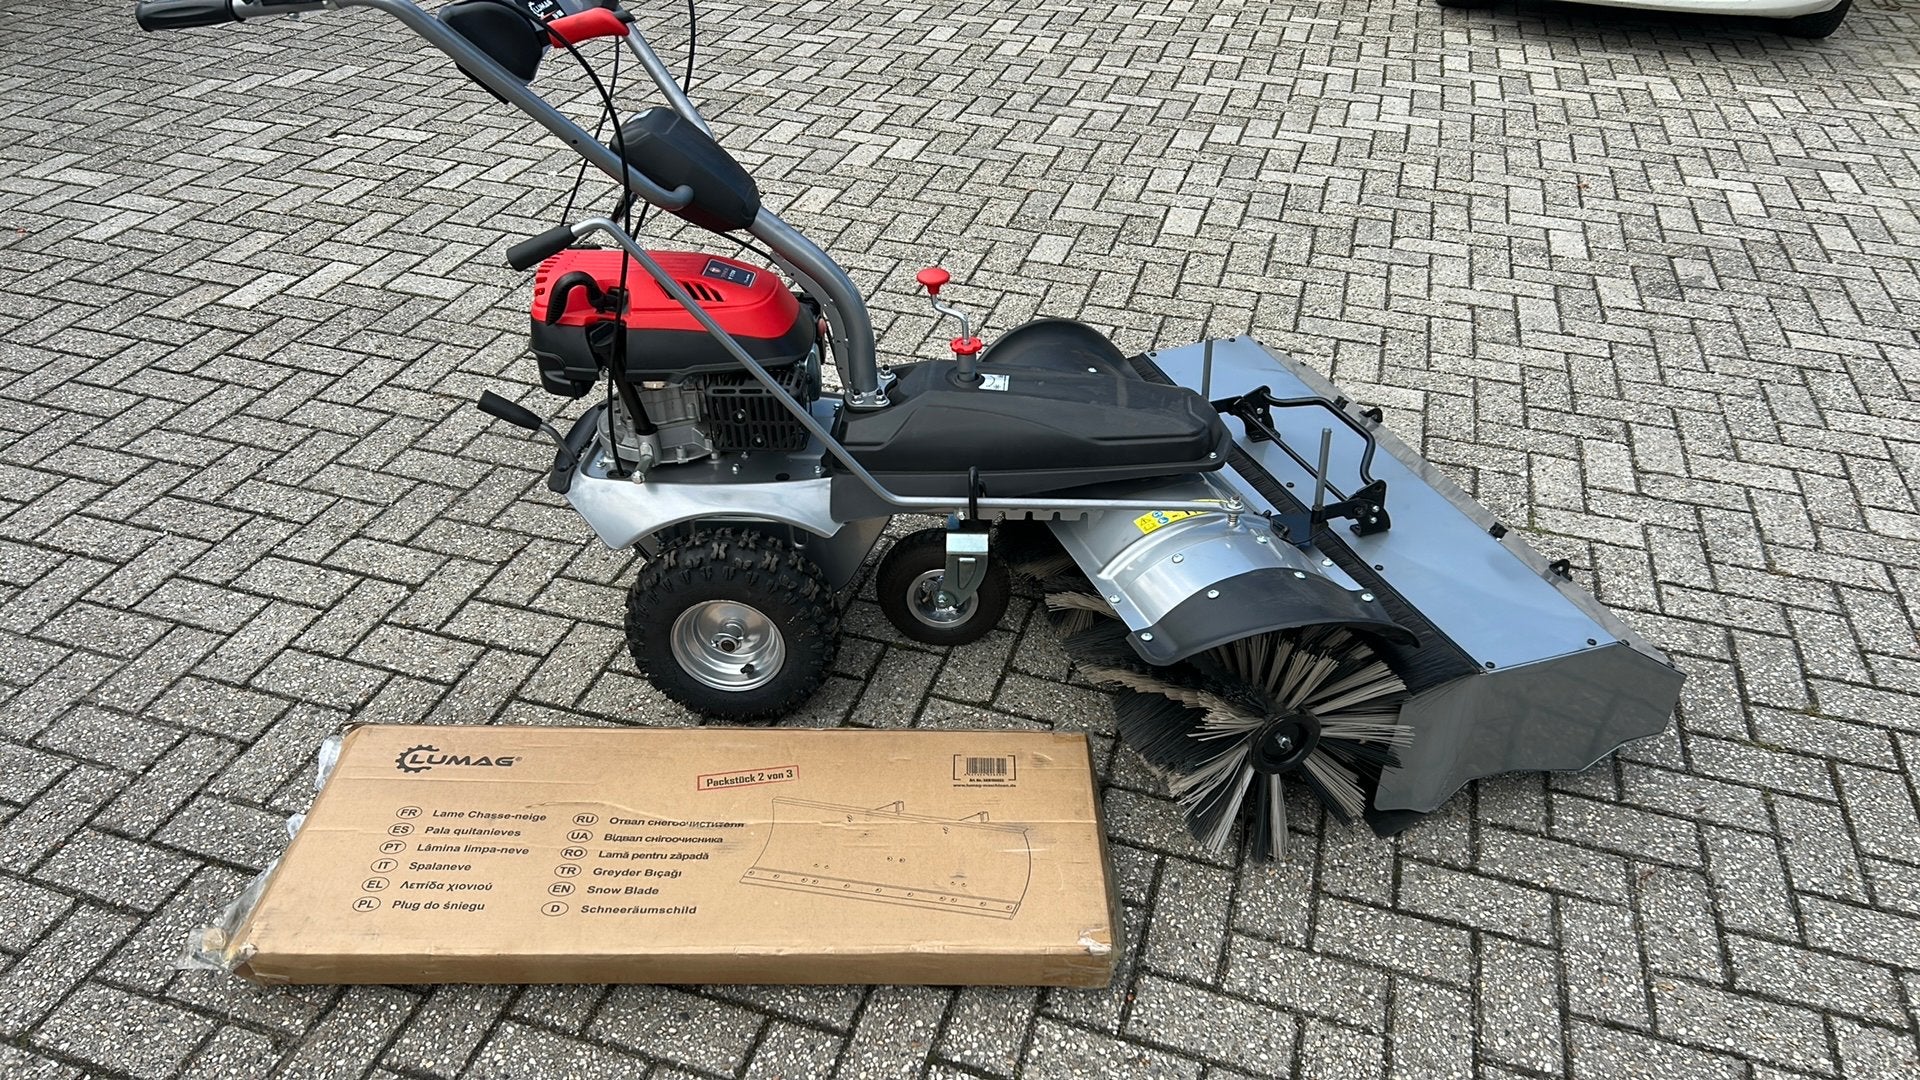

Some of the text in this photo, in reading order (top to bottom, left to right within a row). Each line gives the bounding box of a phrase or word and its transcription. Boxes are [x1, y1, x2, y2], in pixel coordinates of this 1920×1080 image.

[706, 769, 793, 787] Packstück 2 von 3
[399, 808, 547, 823] FR Lame Chasse-neige
[576, 815, 595, 824] RU
[391, 825, 521, 837] ES Pala quitanieves
[570, 831, 589, 841] UA
[384, 842, 530, 855] PT Lâmina limpa-neve
[563, 848, 584, 858] RO
[631, 852, 668, 861] pentru
[377, 861, 472, 872] IT Spalaneve
[558, 866, 577, 876] TR
[593, 867, 642, 878] Greyder
[366, 880, 383, 889] EL
[399, 880, 445, 890] Λεπίδα
[551, 884, 659, 895] EN Snow Blade
[357, 900, 374, 909] PL
[424, 900, 440, 910] do
[550, 904, 697, 914] D Schneeräumschild
